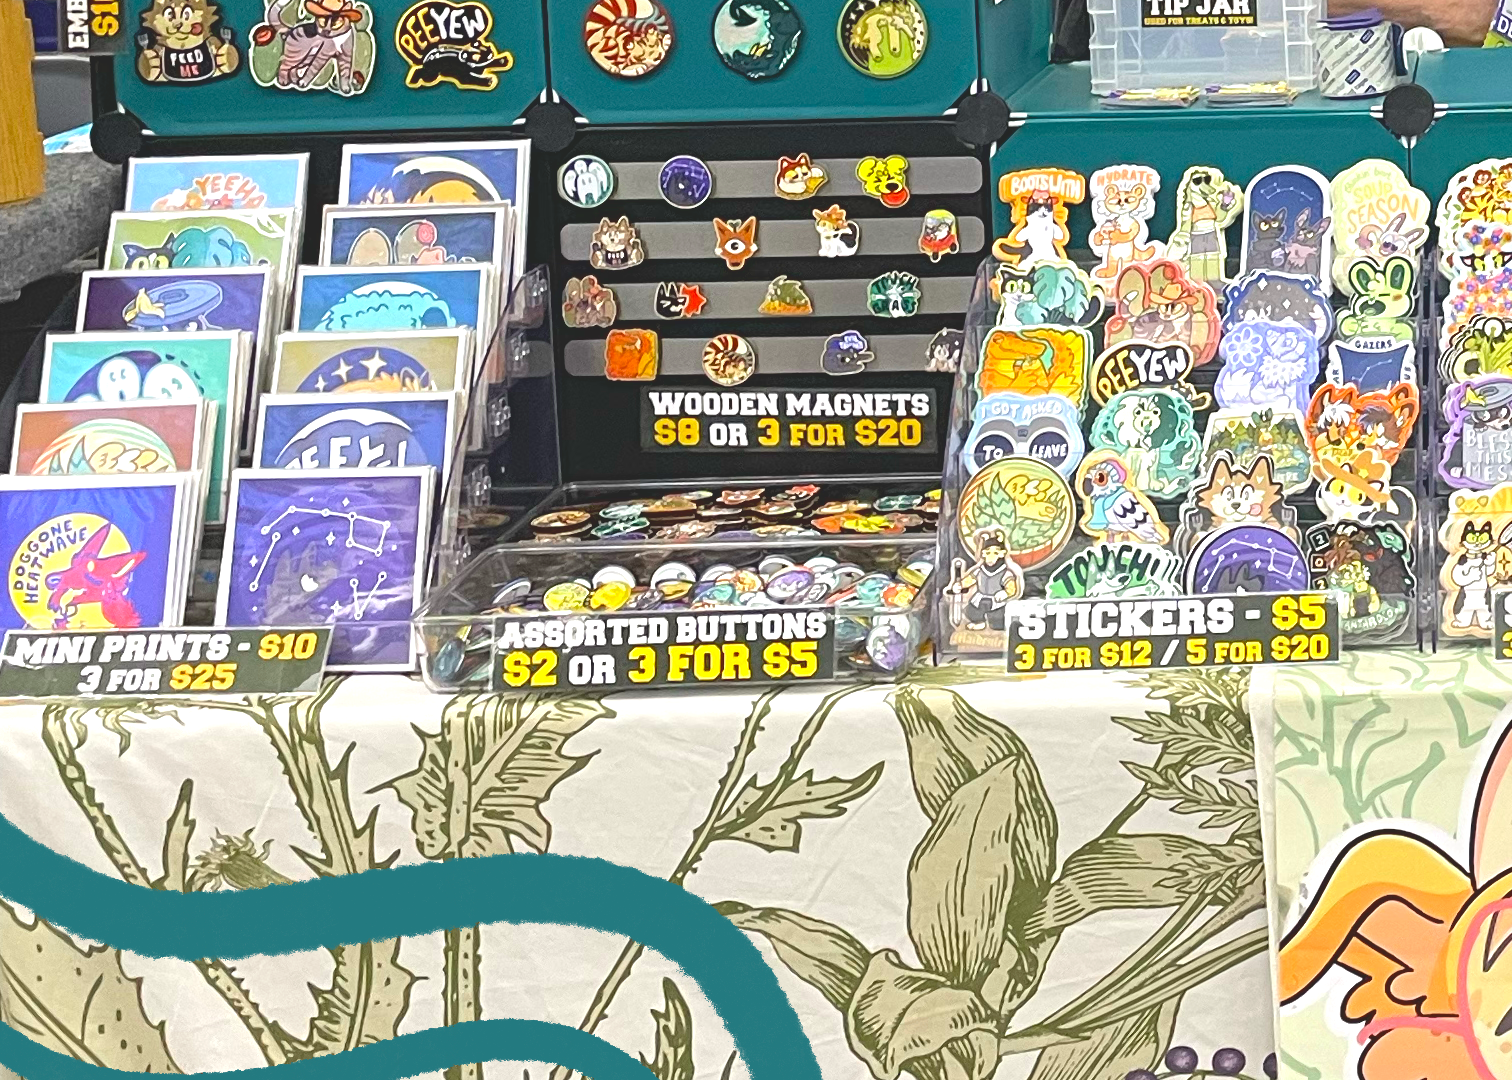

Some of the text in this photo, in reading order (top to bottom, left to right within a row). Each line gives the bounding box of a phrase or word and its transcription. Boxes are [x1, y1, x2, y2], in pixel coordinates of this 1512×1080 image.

[170, 48, 203, 65] FEED
[180, 65, 200, 76] ME
[1096, 172, 1155, 188] HYDRATE
[1353, 182, 1393, 204] SOUP
[1347, 194, 1419, 234] SEASON
[1355, 339, 1393, 350] GAZERS
[648, 391, 930, 417] WOODEN MAGNETS
[992, 402, 1020, 418] GOT
[1022, 401, 1062, 420] ASKED
[1031, 444, 1067, 459] LEAVE
[1476, 450, 1512, 465] THIS
[13, 518, 74, 593] DOGGONE
[24, 526, 90, 604] HEATWAVE
[501, 612, 828, 651] ASSORTED BUTTONS
[1017, 600, 1234, 640] STICKERS
[1272, 597, 1326, 630] $5
[14, 633, 318, 665] MINI PRINTS $10
[1014, 636, 1329, 668] 3 FOR $12 5 FOR $20
[503, 642, 818, 686] $2 OR 3 FOR $5
